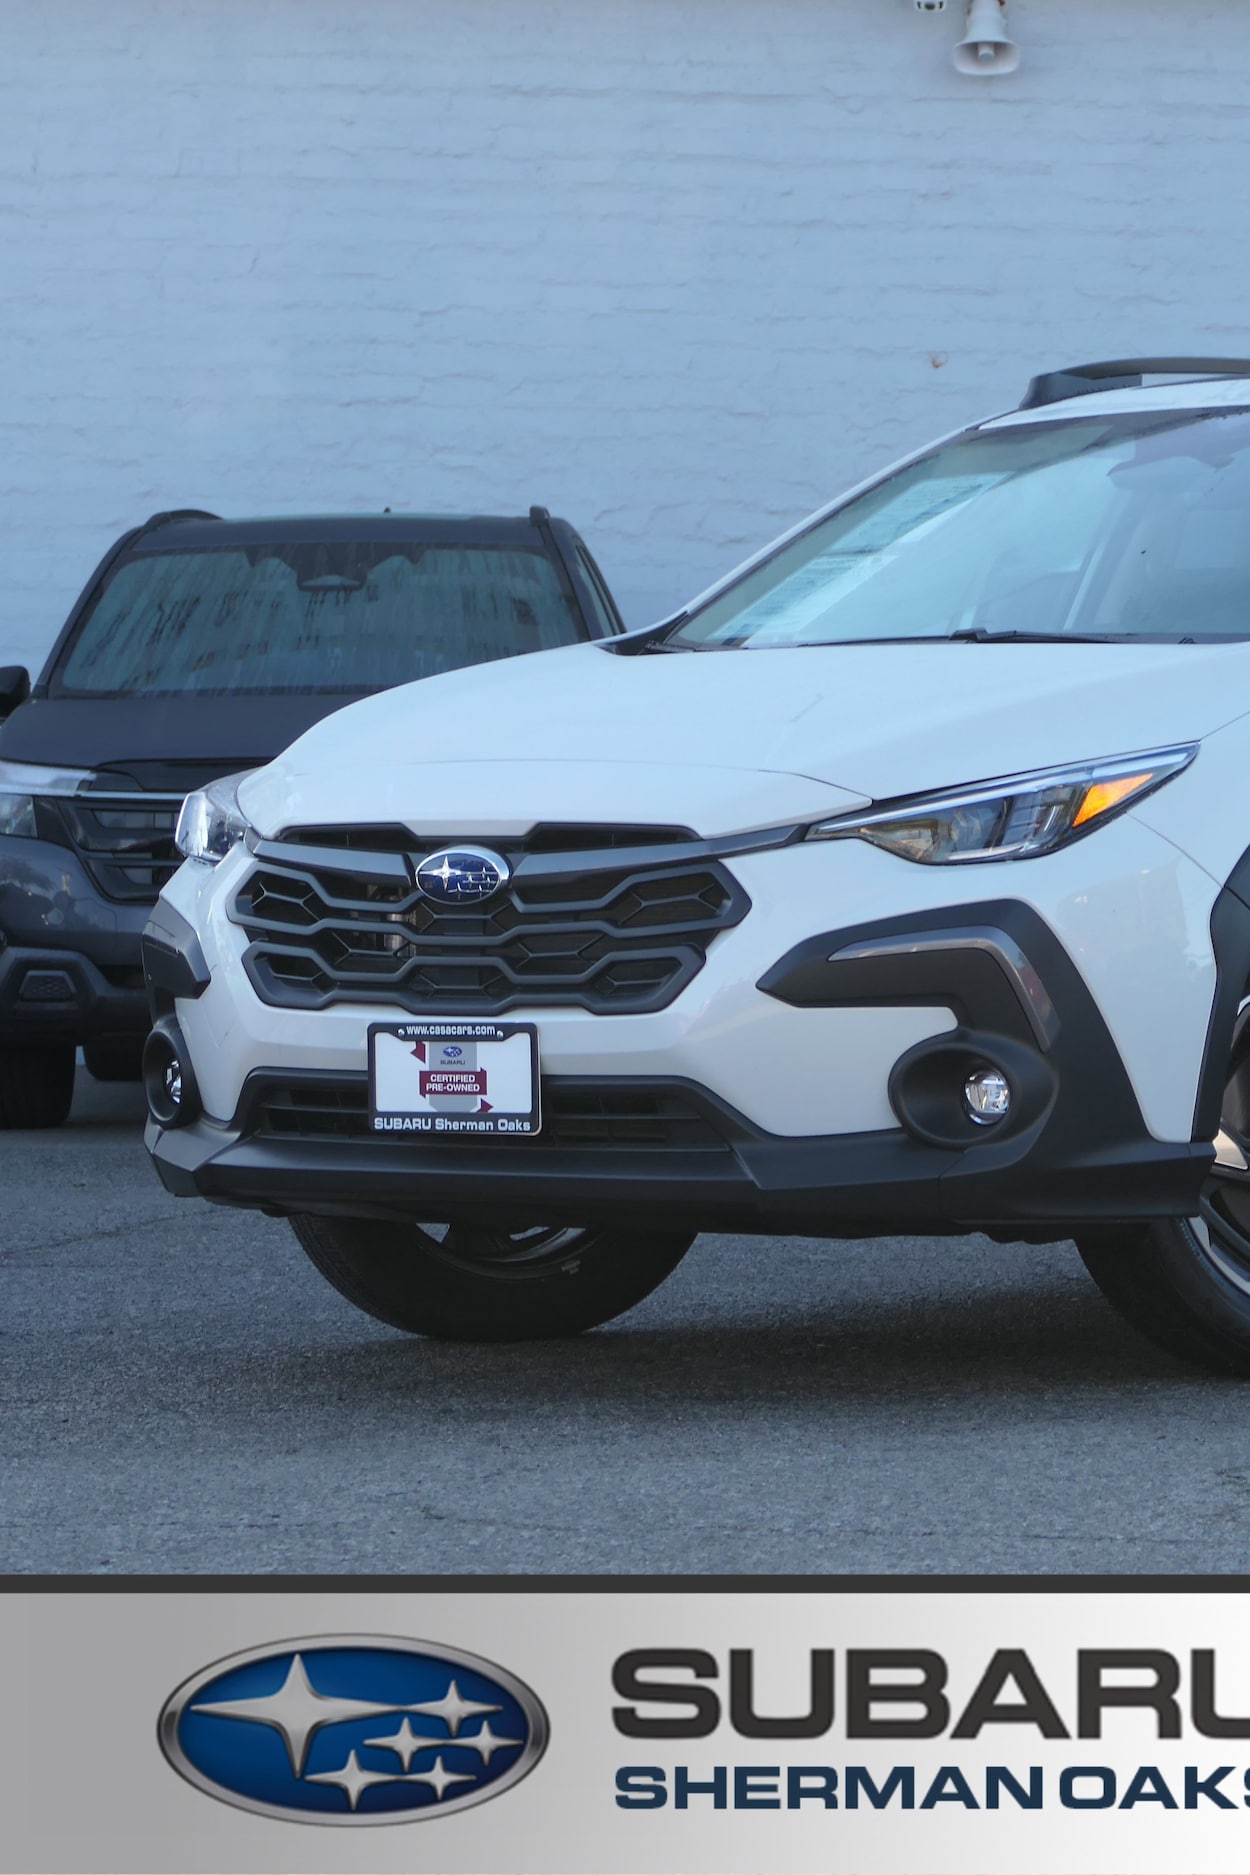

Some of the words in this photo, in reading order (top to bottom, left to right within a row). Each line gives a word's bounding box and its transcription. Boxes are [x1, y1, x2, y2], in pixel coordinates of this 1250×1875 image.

[406, 1025, 496, 1036] www.casacars.com
[430, 1074, 476, 1083] CERTIFIED
[426, 1083, 480, 1092] PRE-OWNED
[374, 1117, 432, 1130] SUBARU
[435, 1118, 494, 1131] Sherman
[497, 1119, 531, 1132] Oaks
